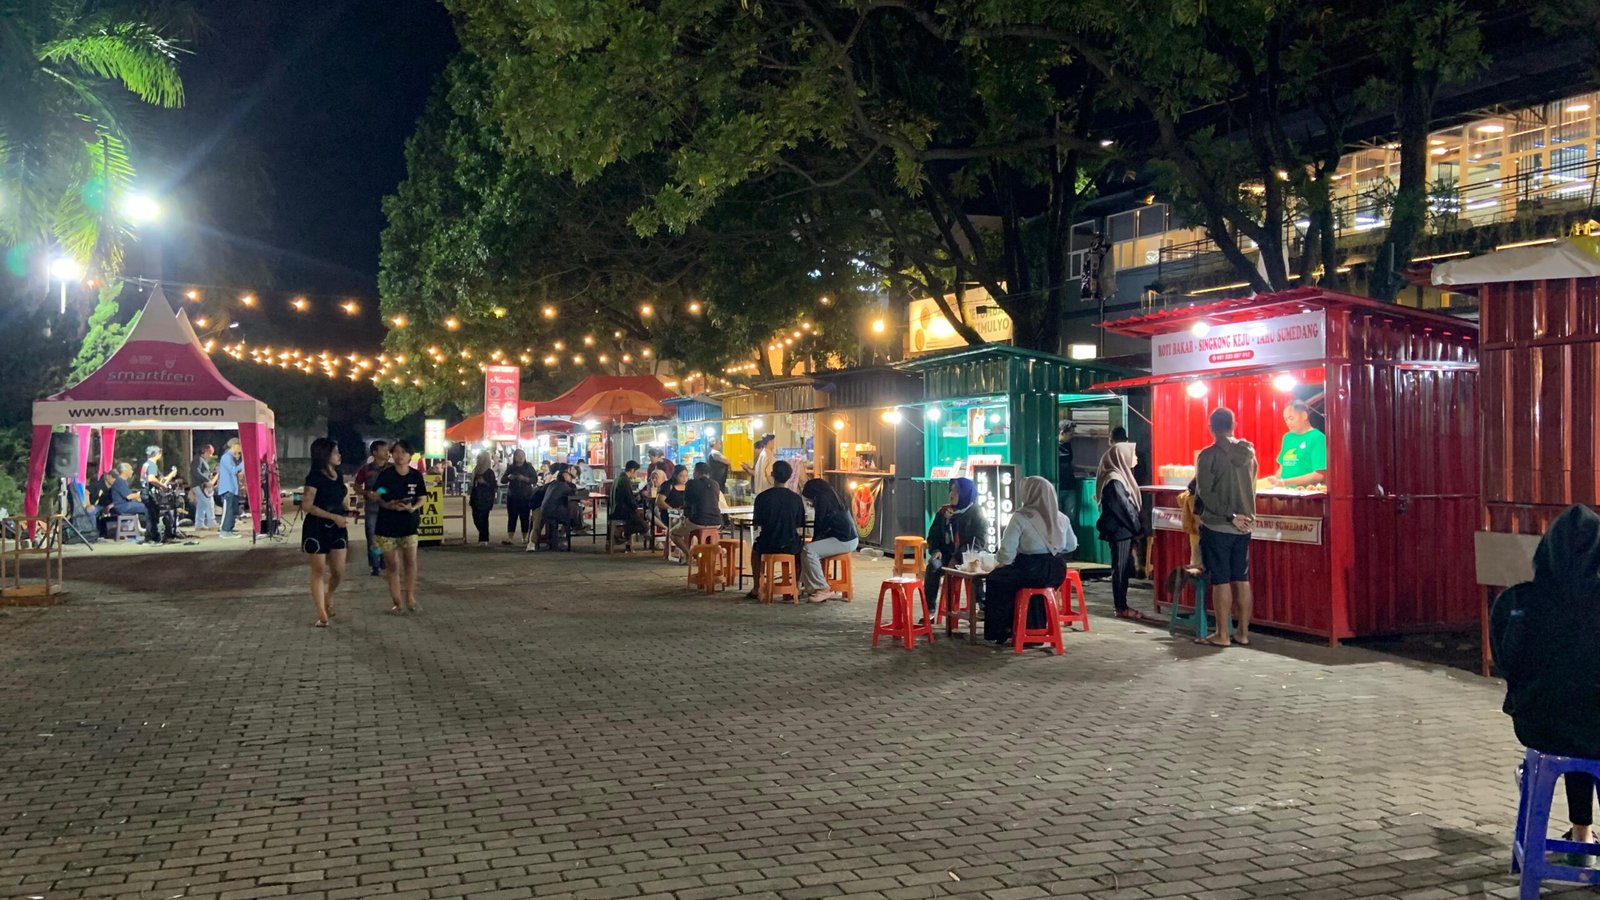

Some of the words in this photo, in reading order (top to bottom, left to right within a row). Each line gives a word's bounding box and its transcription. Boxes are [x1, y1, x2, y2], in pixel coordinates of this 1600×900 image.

[1158, 343, 1171, 357] ROTI
[1173, 340, 1194, 355] BAKAR
[1198, 335, 1231, 352] SINGKONG
[1233, 333, 1250, 347] KEJU
[1276, 322, 1319, 342] SUMEDANG
[107, 369, 195, 382] smartfren
[68, 404, 225, 418] www.smartfren.com
[1255, 519, 1273, 530] TAHU
[1275, 521, 1314, 533] SUMEDANG
